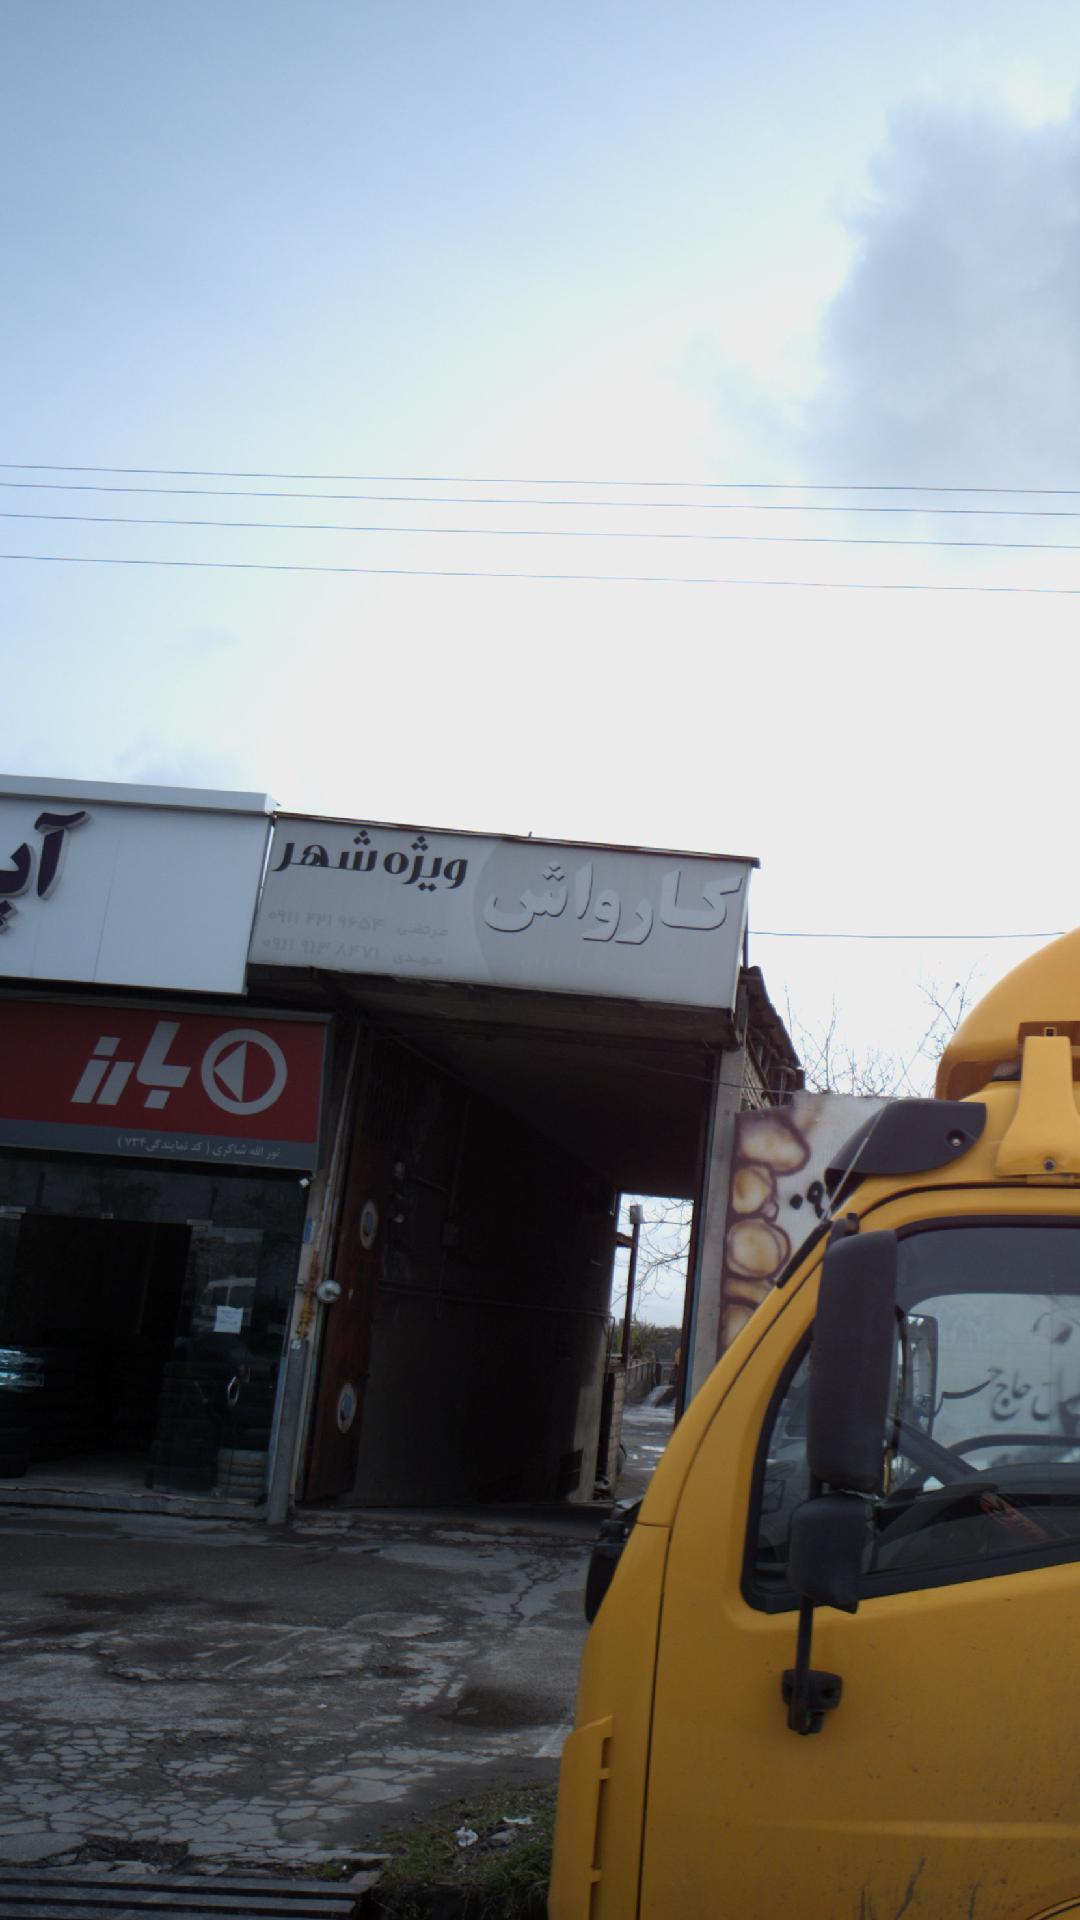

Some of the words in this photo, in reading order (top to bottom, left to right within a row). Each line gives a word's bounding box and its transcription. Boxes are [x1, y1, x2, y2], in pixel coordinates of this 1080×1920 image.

[272, 829, 378, 872] شهر
[383, 834, 469, 892] ویژه
[483, 861, 744, 945] کارواش
[71, 1020, 192, 1110] بارز
